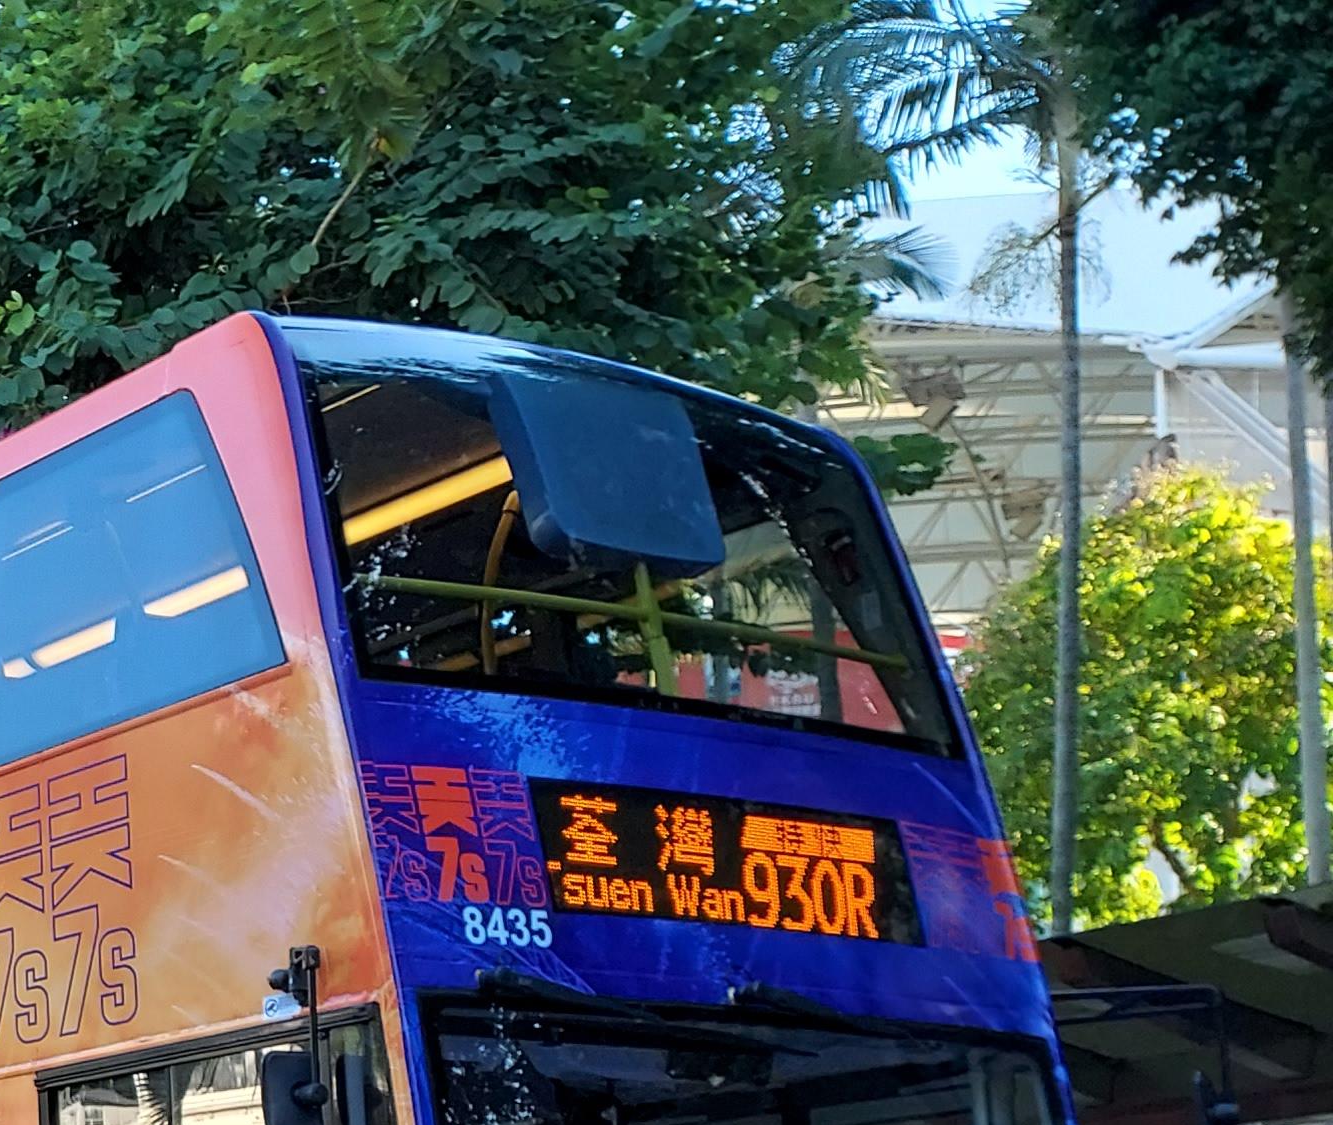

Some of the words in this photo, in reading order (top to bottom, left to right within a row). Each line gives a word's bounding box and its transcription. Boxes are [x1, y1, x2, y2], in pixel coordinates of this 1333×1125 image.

[559, 793, 716, 878] 荃灣
[462, 906, 554, 949] 8435
[546, 860, 655, 914] suen
[666, 872, 748, 924] Wan
[741, 852, 880, 940] 930R
